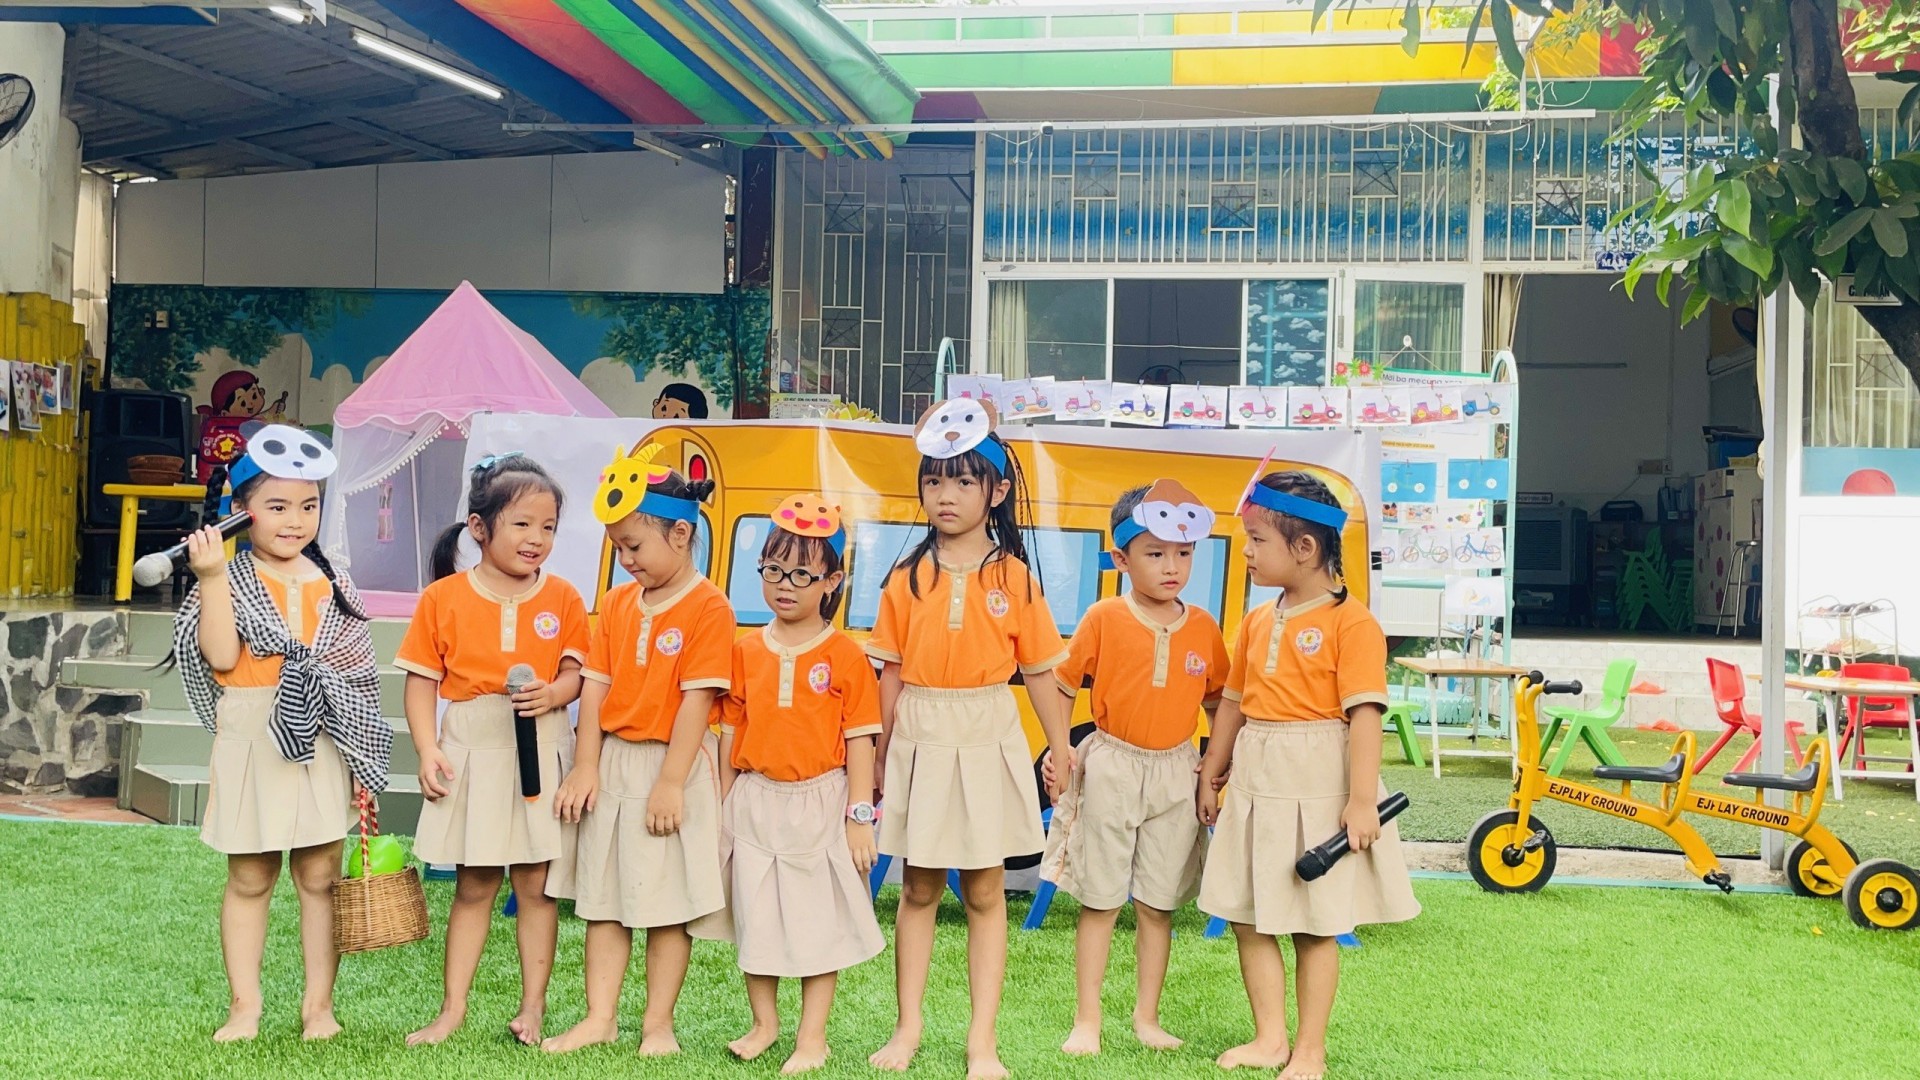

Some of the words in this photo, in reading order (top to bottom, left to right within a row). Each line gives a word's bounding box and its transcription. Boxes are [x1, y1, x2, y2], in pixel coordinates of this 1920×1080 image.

[1549, 783, 1590, 803] EJPLAY
[1591, 795, 1638, 817] GROUND
[1741, 807, 1790, 826] GROUND
